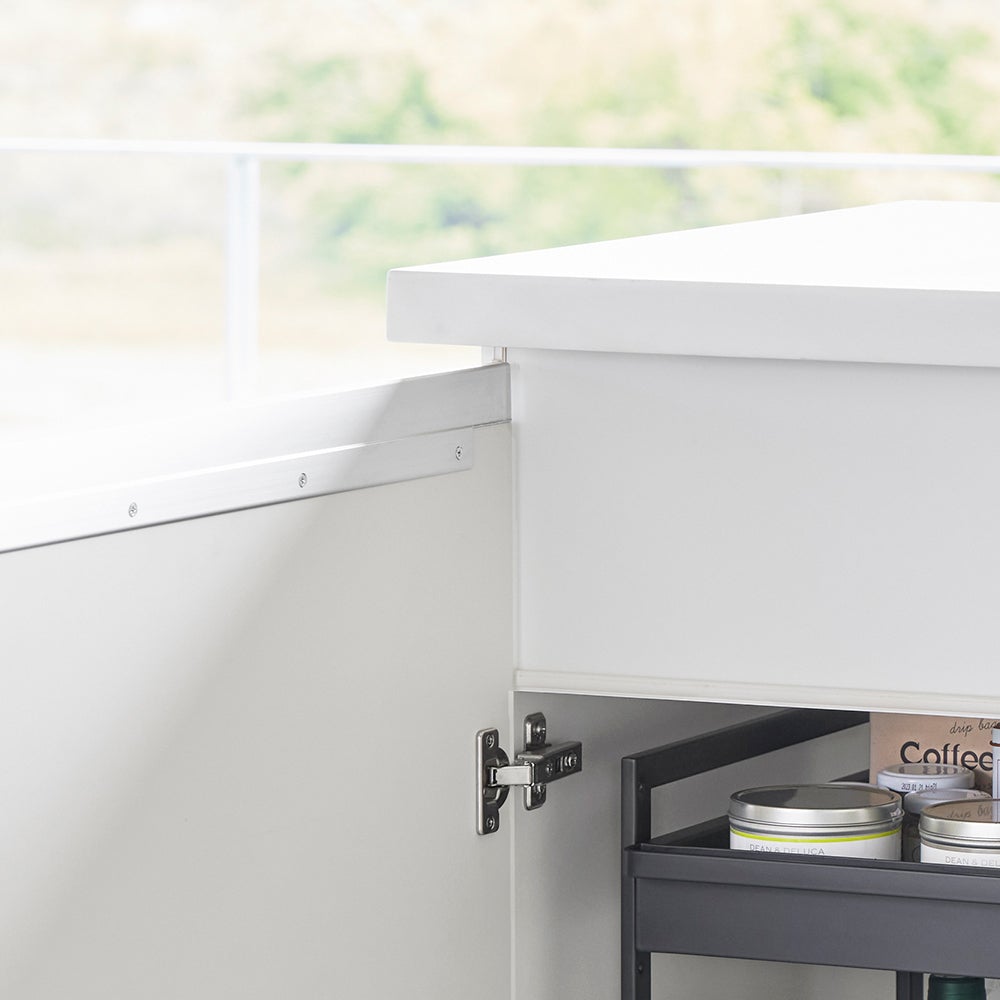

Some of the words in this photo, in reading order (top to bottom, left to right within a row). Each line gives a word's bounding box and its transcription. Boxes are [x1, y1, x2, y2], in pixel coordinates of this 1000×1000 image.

[950, 720, 973, 737] drip
[900, 741, 993, 771] Coffee
[945, 856, 969, 865] DEAN
[971, 858, 978, 866] &
